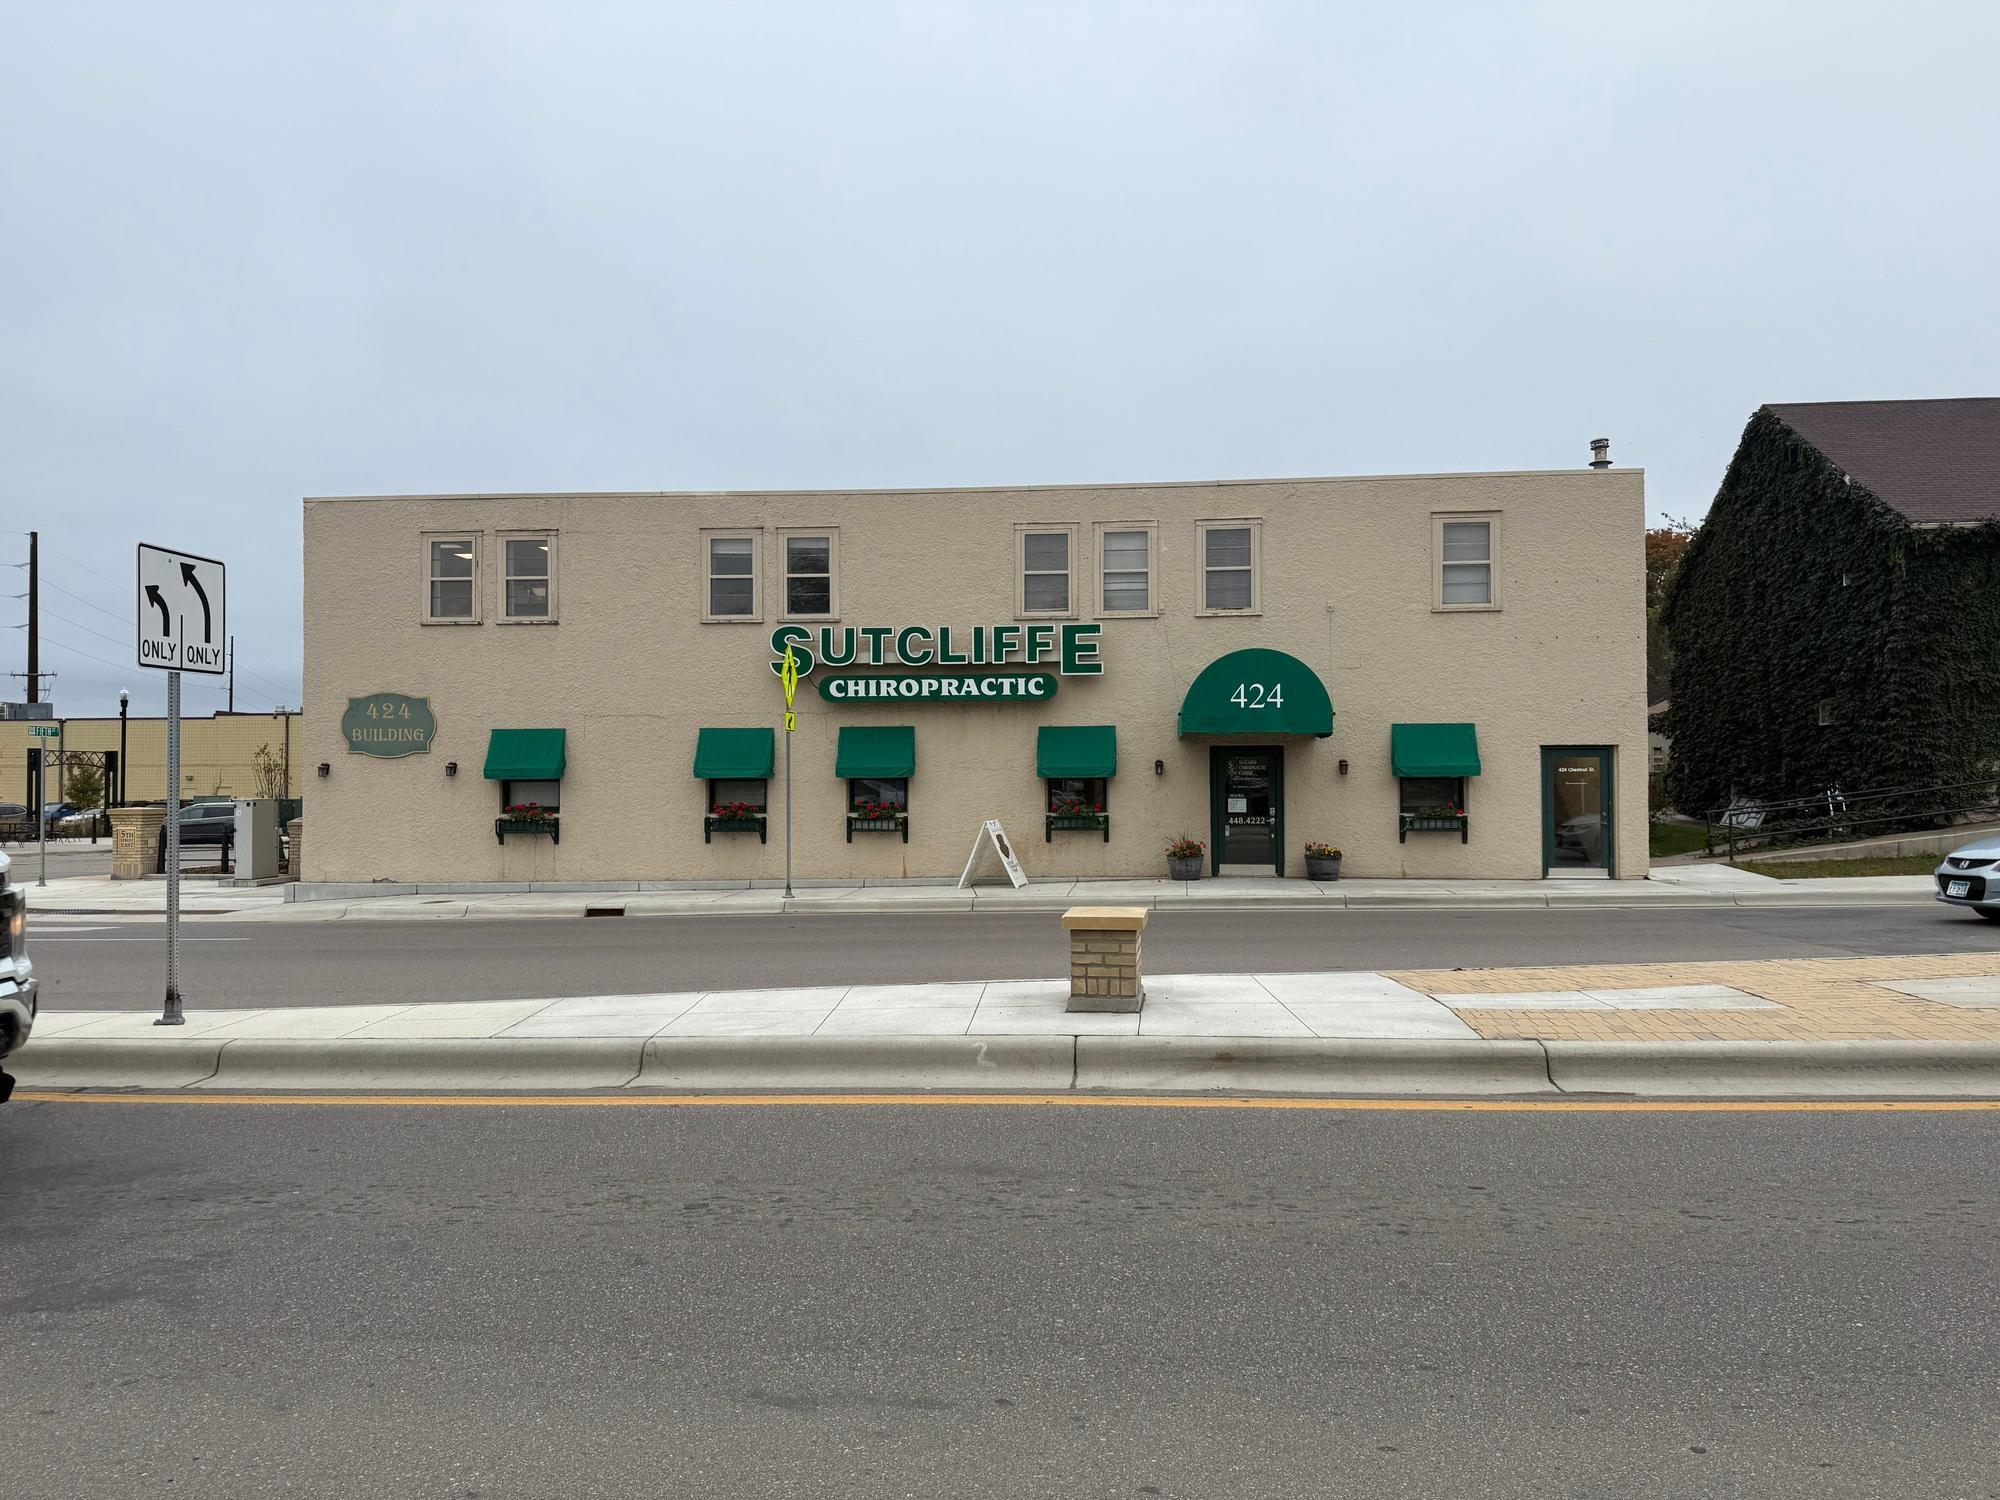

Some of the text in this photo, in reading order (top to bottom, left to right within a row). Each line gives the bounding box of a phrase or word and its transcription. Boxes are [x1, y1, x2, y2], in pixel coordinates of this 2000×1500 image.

[142, 639, 176, 661] ONLY
[187, 645, 220, 665] ONLY
[769, 622, 1105, 679] SUTCLIFFE
[828, 677, 1044, 698] CHIROPRACTIC
[1230, 683, 1284, 709] 424
[366, 702, 412, 719] 424
[36, 726, 52, 737] FIFTH
[352, 728, 425, 741] BUILDING
[120, 830, 134, 838] 5TH
